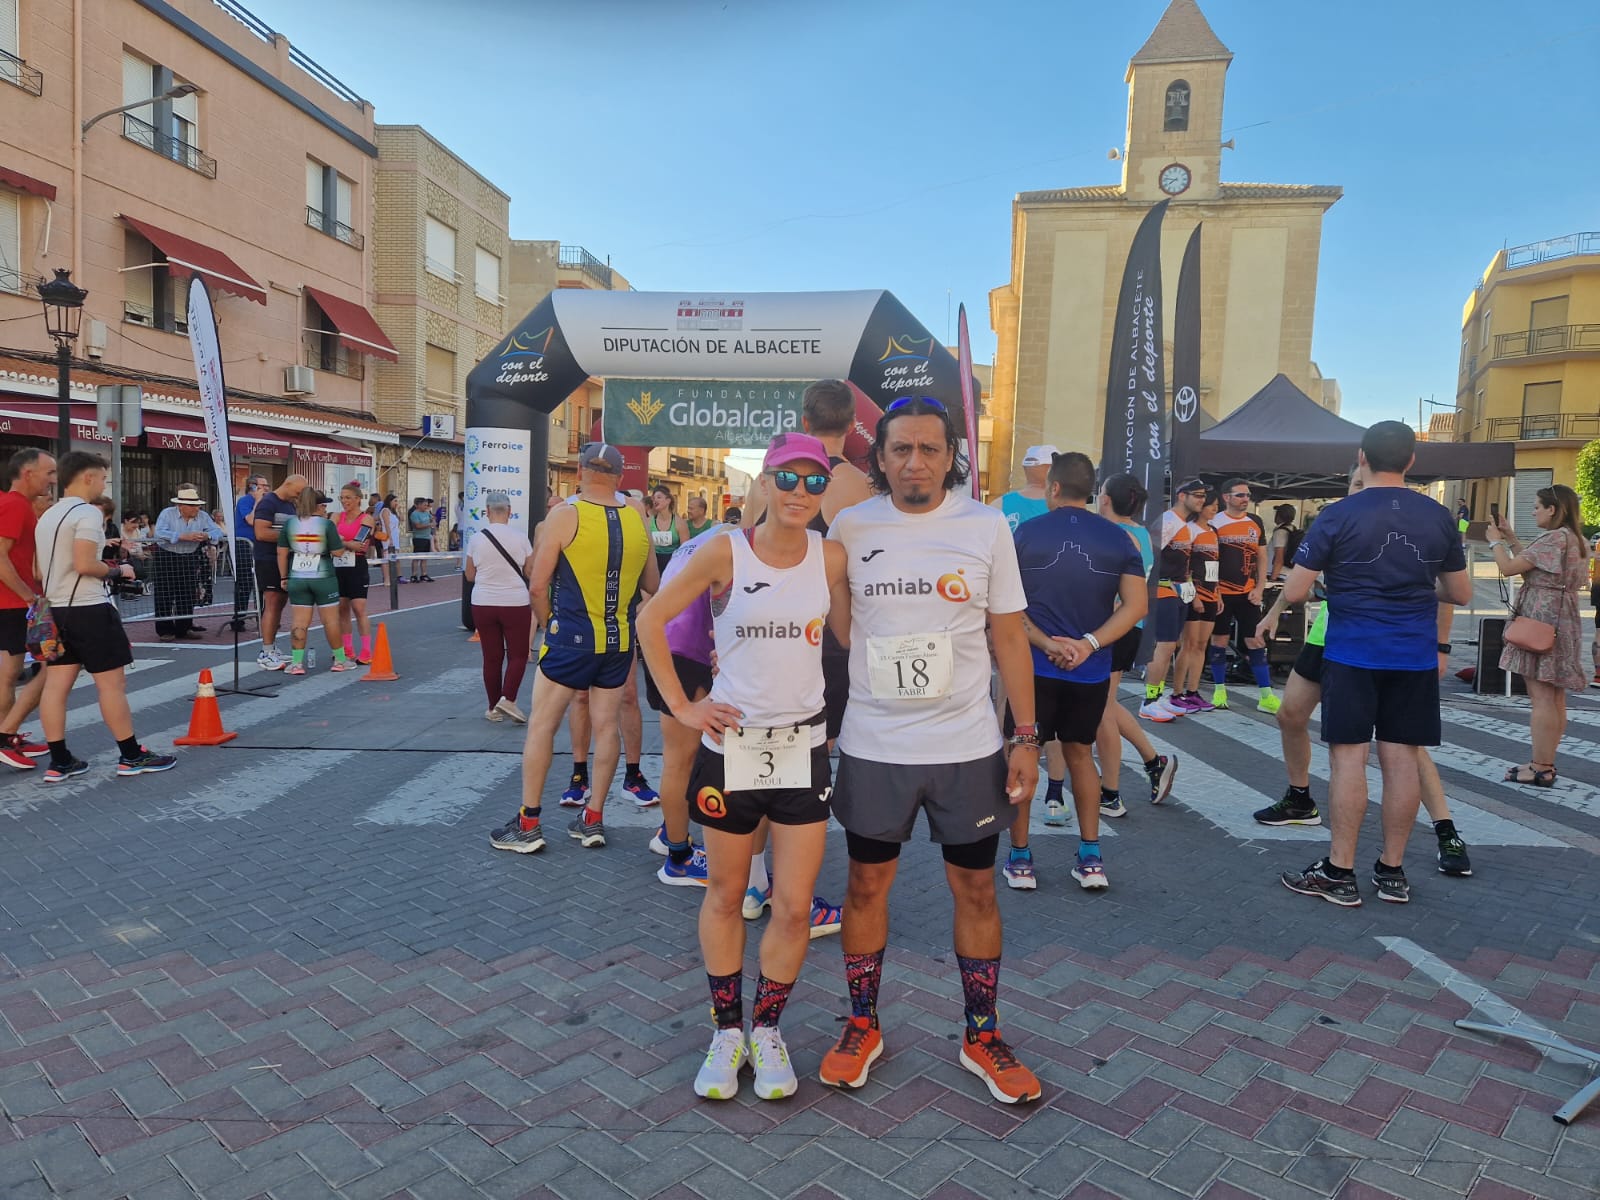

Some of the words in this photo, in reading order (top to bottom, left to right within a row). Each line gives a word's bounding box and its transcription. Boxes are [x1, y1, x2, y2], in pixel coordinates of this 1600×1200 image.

[1130, 270, 1145, 360] ALBACETE
[603, 337, 700, 353] DIPUTACIÓN
[707, 340, 728, 353] DE
[733, 339, 821, 354] ALBACETE
[1141, 296, 1160, 381] deporte
[501, 361, 524, 371] con
[529, 356, 544, 370] el
[884, 366, 909, 377] con
[913, 361, 929, 373] el
[496, 371, 549, 386] deporte
[881, 375, 934, 392] deporte
[1128, 367, 1137, 392] DE
[678, 388, 796, 400] FUNDACIÓN
[1142, 390, 1158, 412] el
[669, 401, 797, 435] Globalcaja
[1125, 396, 1136, 474] UTACIÓN
[1149, 421, 1161, 460] con
[482, 440, 524, 451] Ferroice
[481, 463, 520, 474] Ferlabs
[864, 577, 932, 597] amiab
[735, 621, 801, 639] amiab
[893, 658, 930, 689] 18
[898, 688, 926, 697] FABRI
[759, 751, 775, 778] 3
[753, 777, 782, 787] PAQUI
